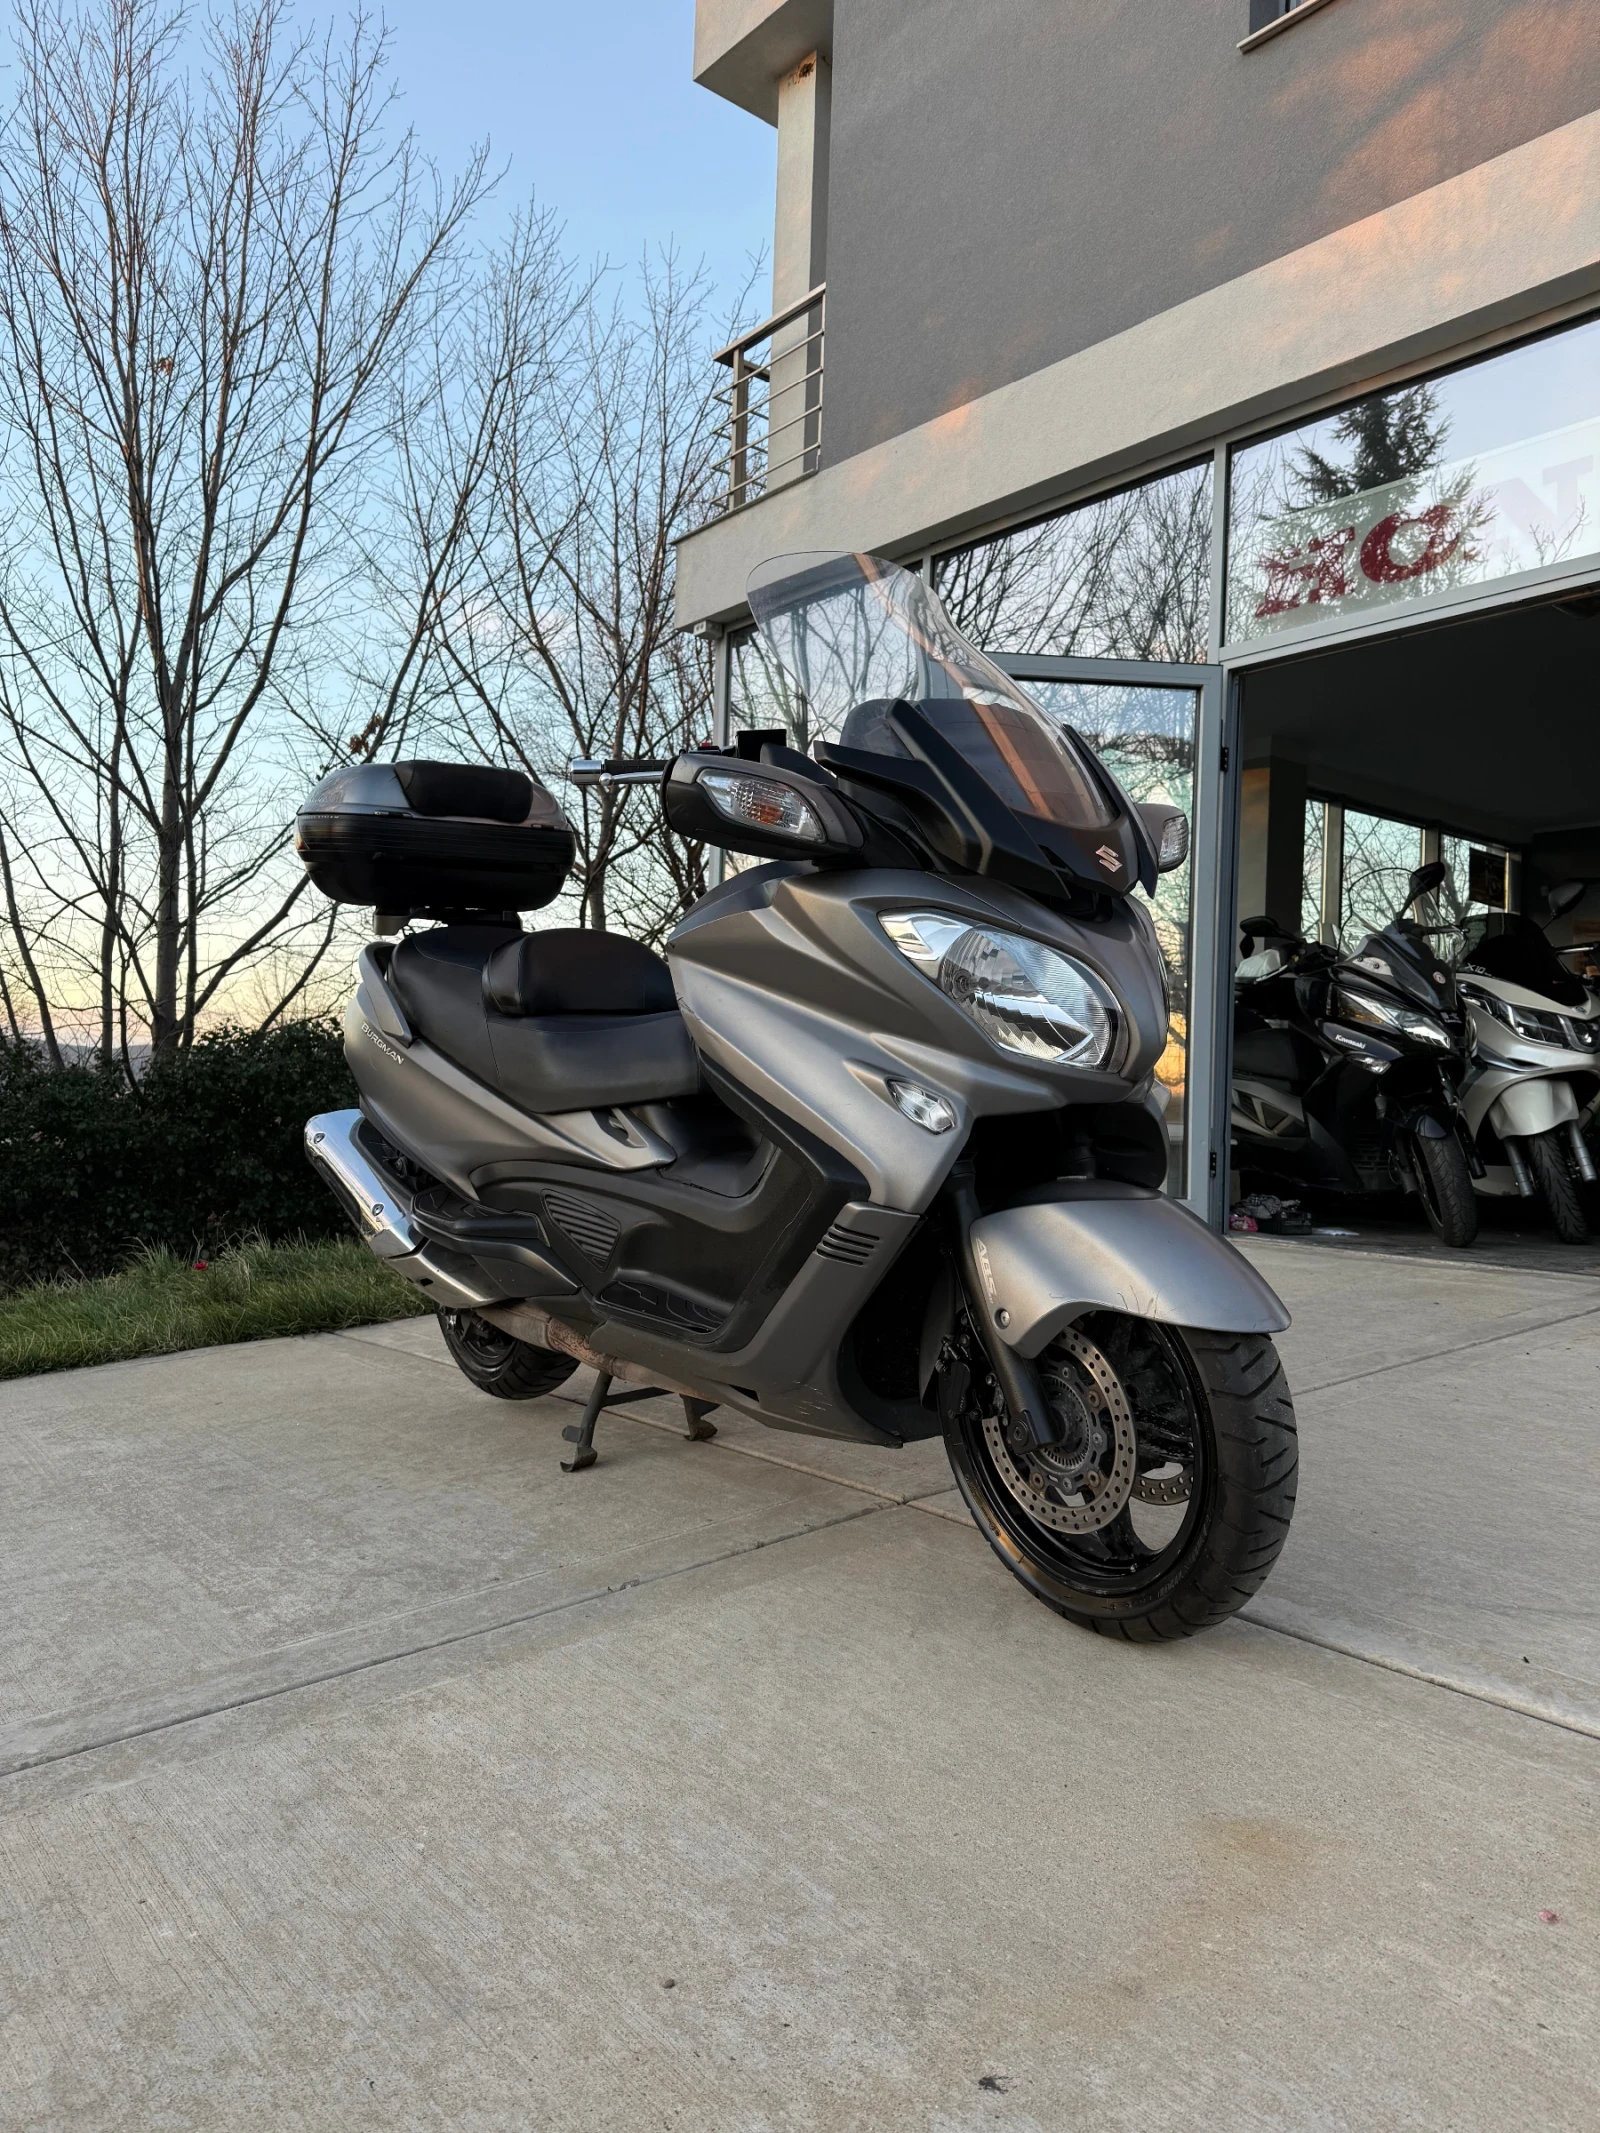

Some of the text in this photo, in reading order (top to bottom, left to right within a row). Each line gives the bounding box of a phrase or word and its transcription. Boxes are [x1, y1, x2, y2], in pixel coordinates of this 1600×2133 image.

[361, 1021, 405, 1065] BURGMAN
[1335, 1034, 1366, 1049] Kawasaki
[976, 1237, 997, 1299] ABS
